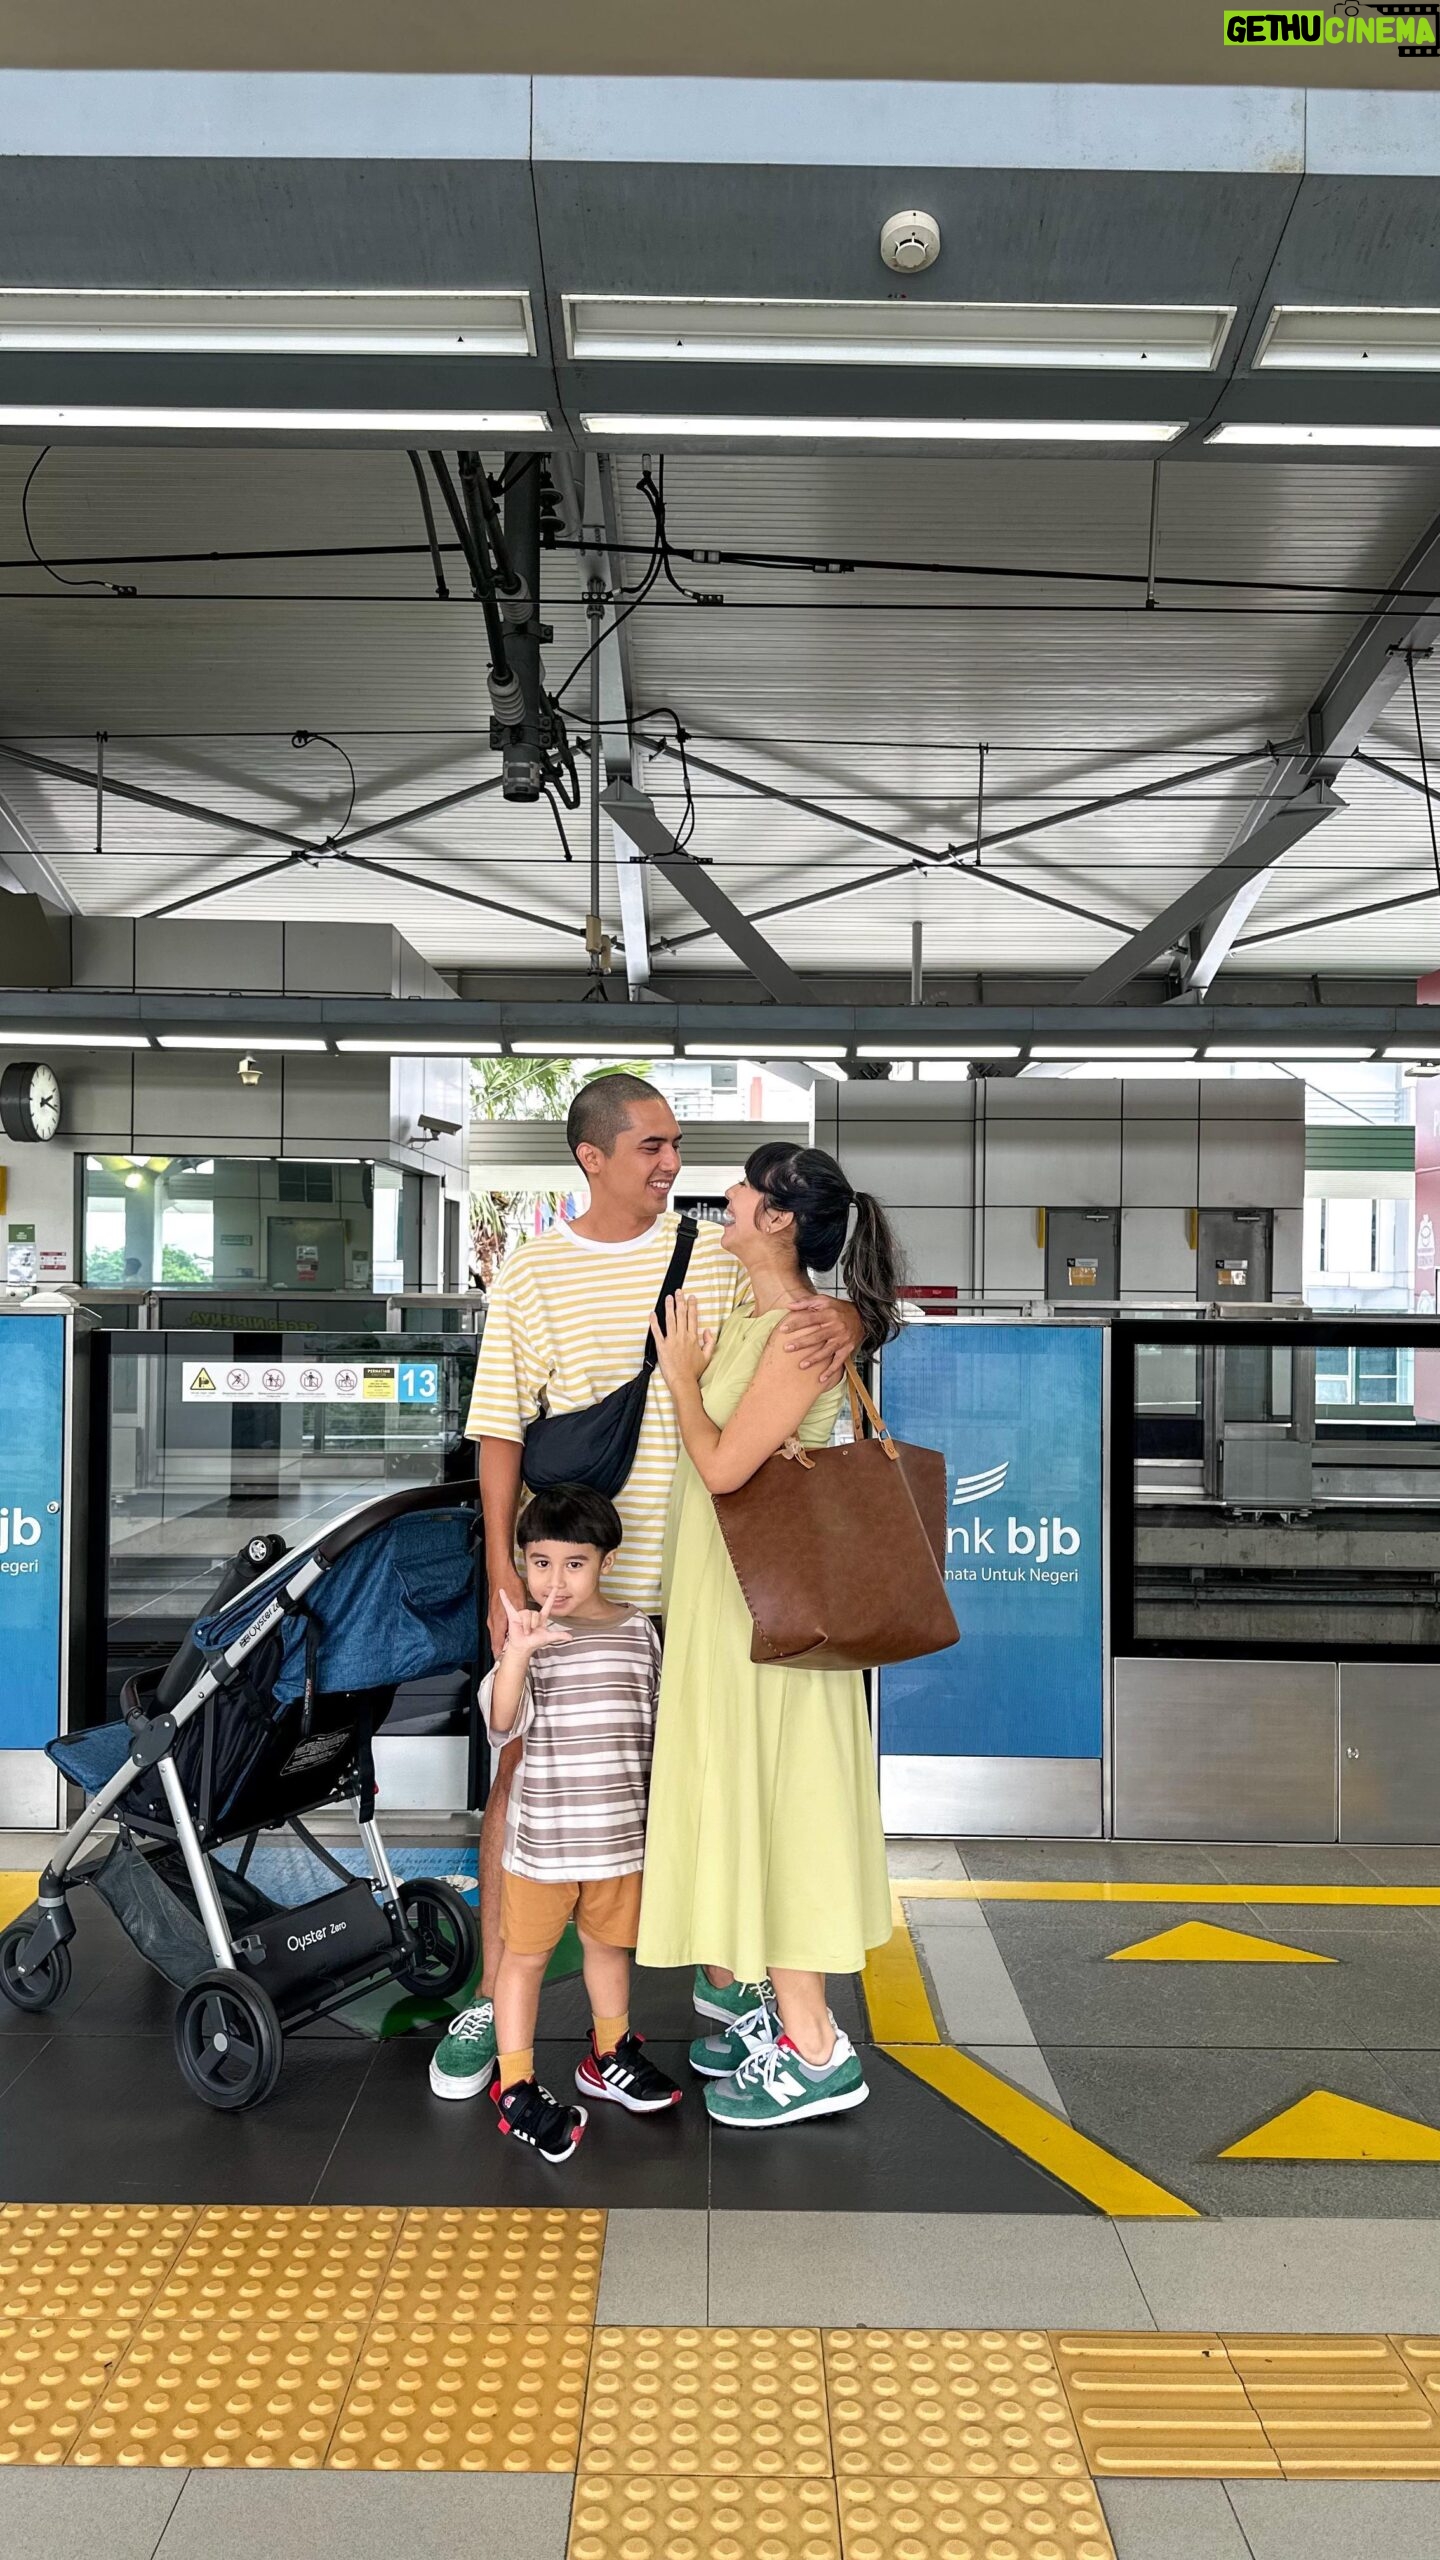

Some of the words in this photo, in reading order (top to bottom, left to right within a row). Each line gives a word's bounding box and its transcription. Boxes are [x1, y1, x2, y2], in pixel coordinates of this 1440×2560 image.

[402, 1368, 436, 1398] 13
[0, 1507, 42, 1555] jb
[947, 1516, 996, 1555] nk
[1008, 1516, 1081, 1563] bjb
[0, 1559, 39, 1577] egeri
[981, 1567, 1026, 1581] Untuk
[1030, 1567, 1079, 1586] Negeri
[287, 1926, 327, 1952] Oyster
[329, 1921, 347, 1935] Zero
